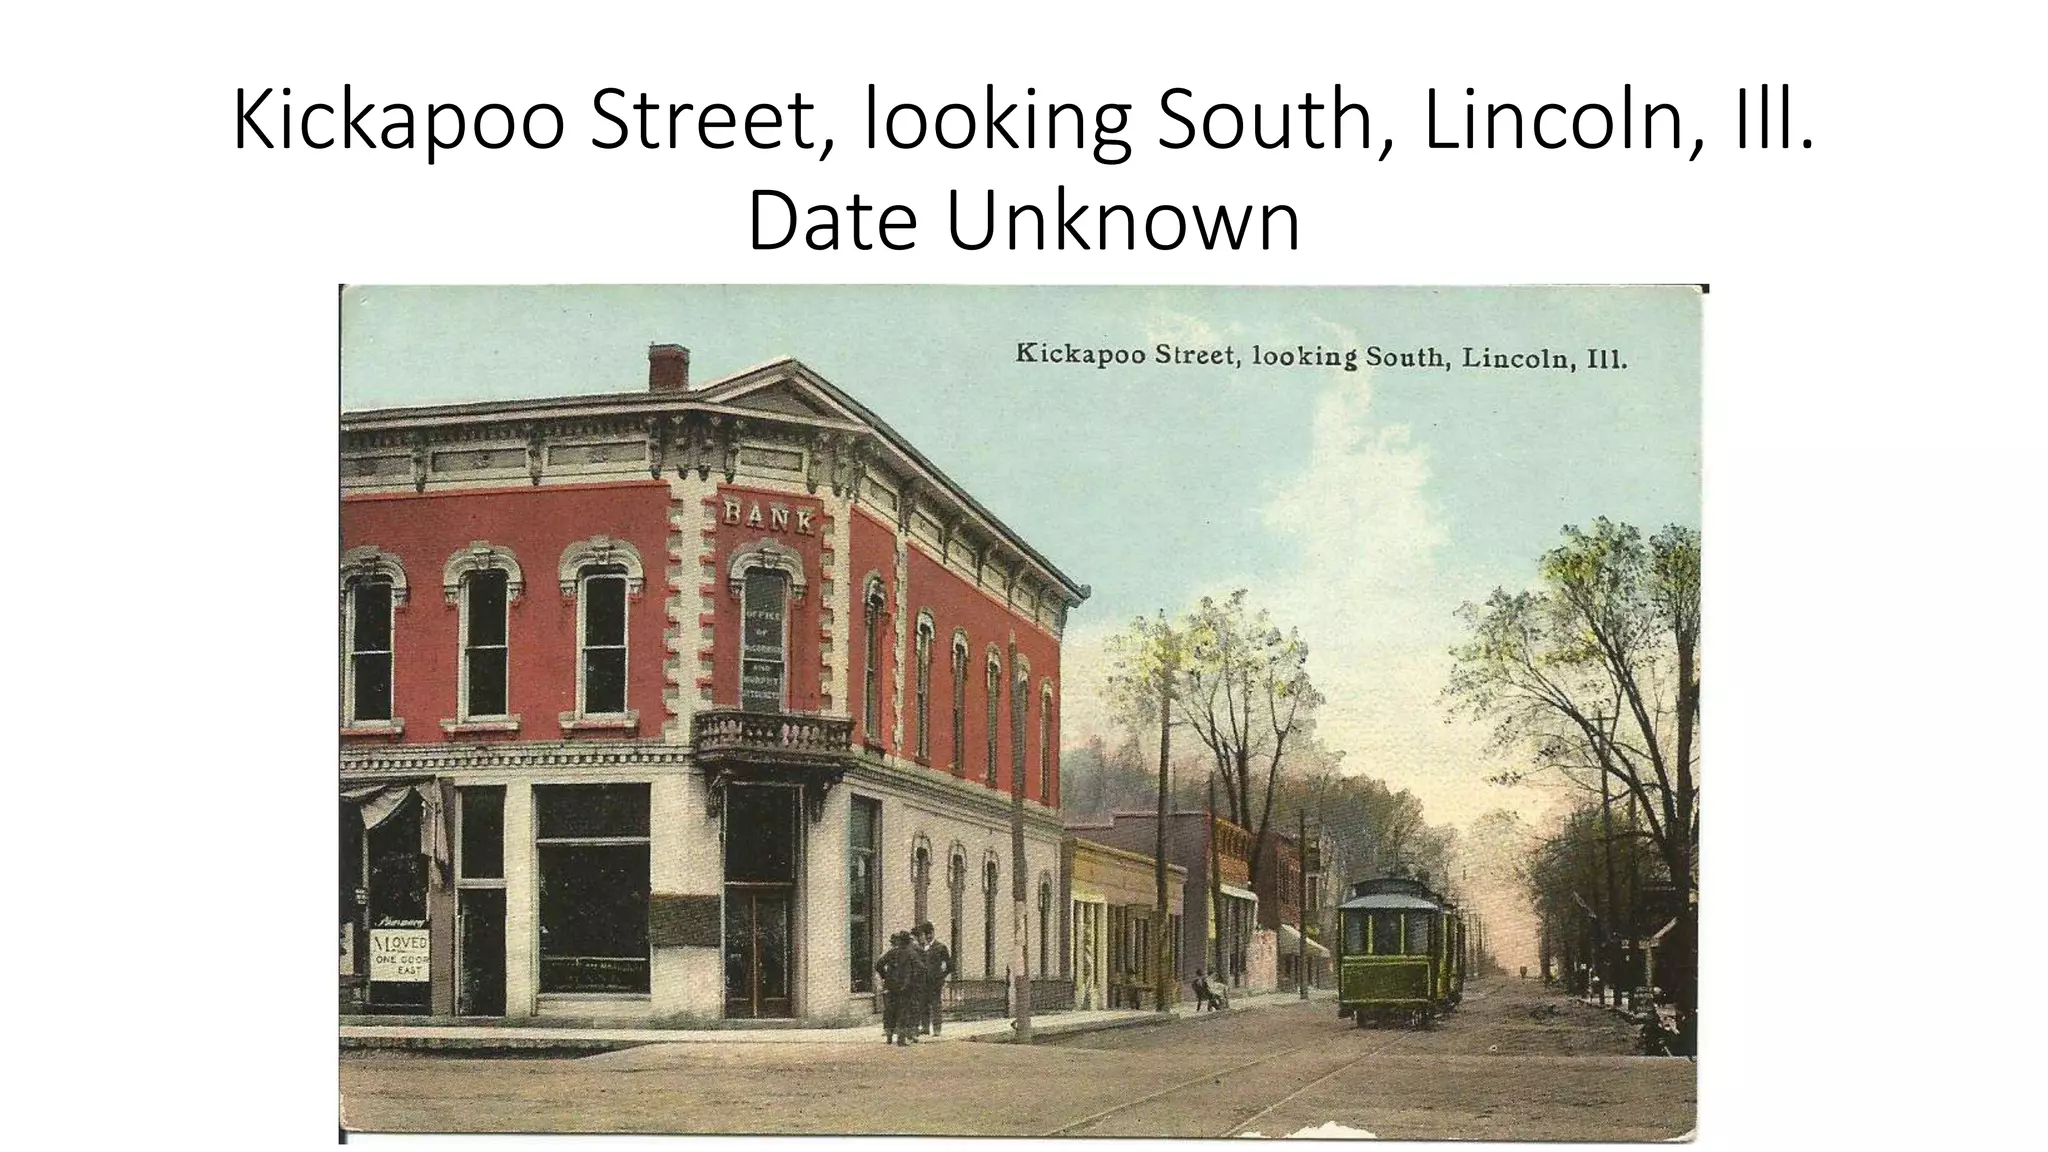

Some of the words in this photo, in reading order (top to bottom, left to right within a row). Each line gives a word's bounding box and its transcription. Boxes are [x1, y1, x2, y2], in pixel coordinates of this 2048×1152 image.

[723, 496, 817, 536] BANK
[376, 955, 397, 964] ONE
[398, 966, 422, 975] EAST
